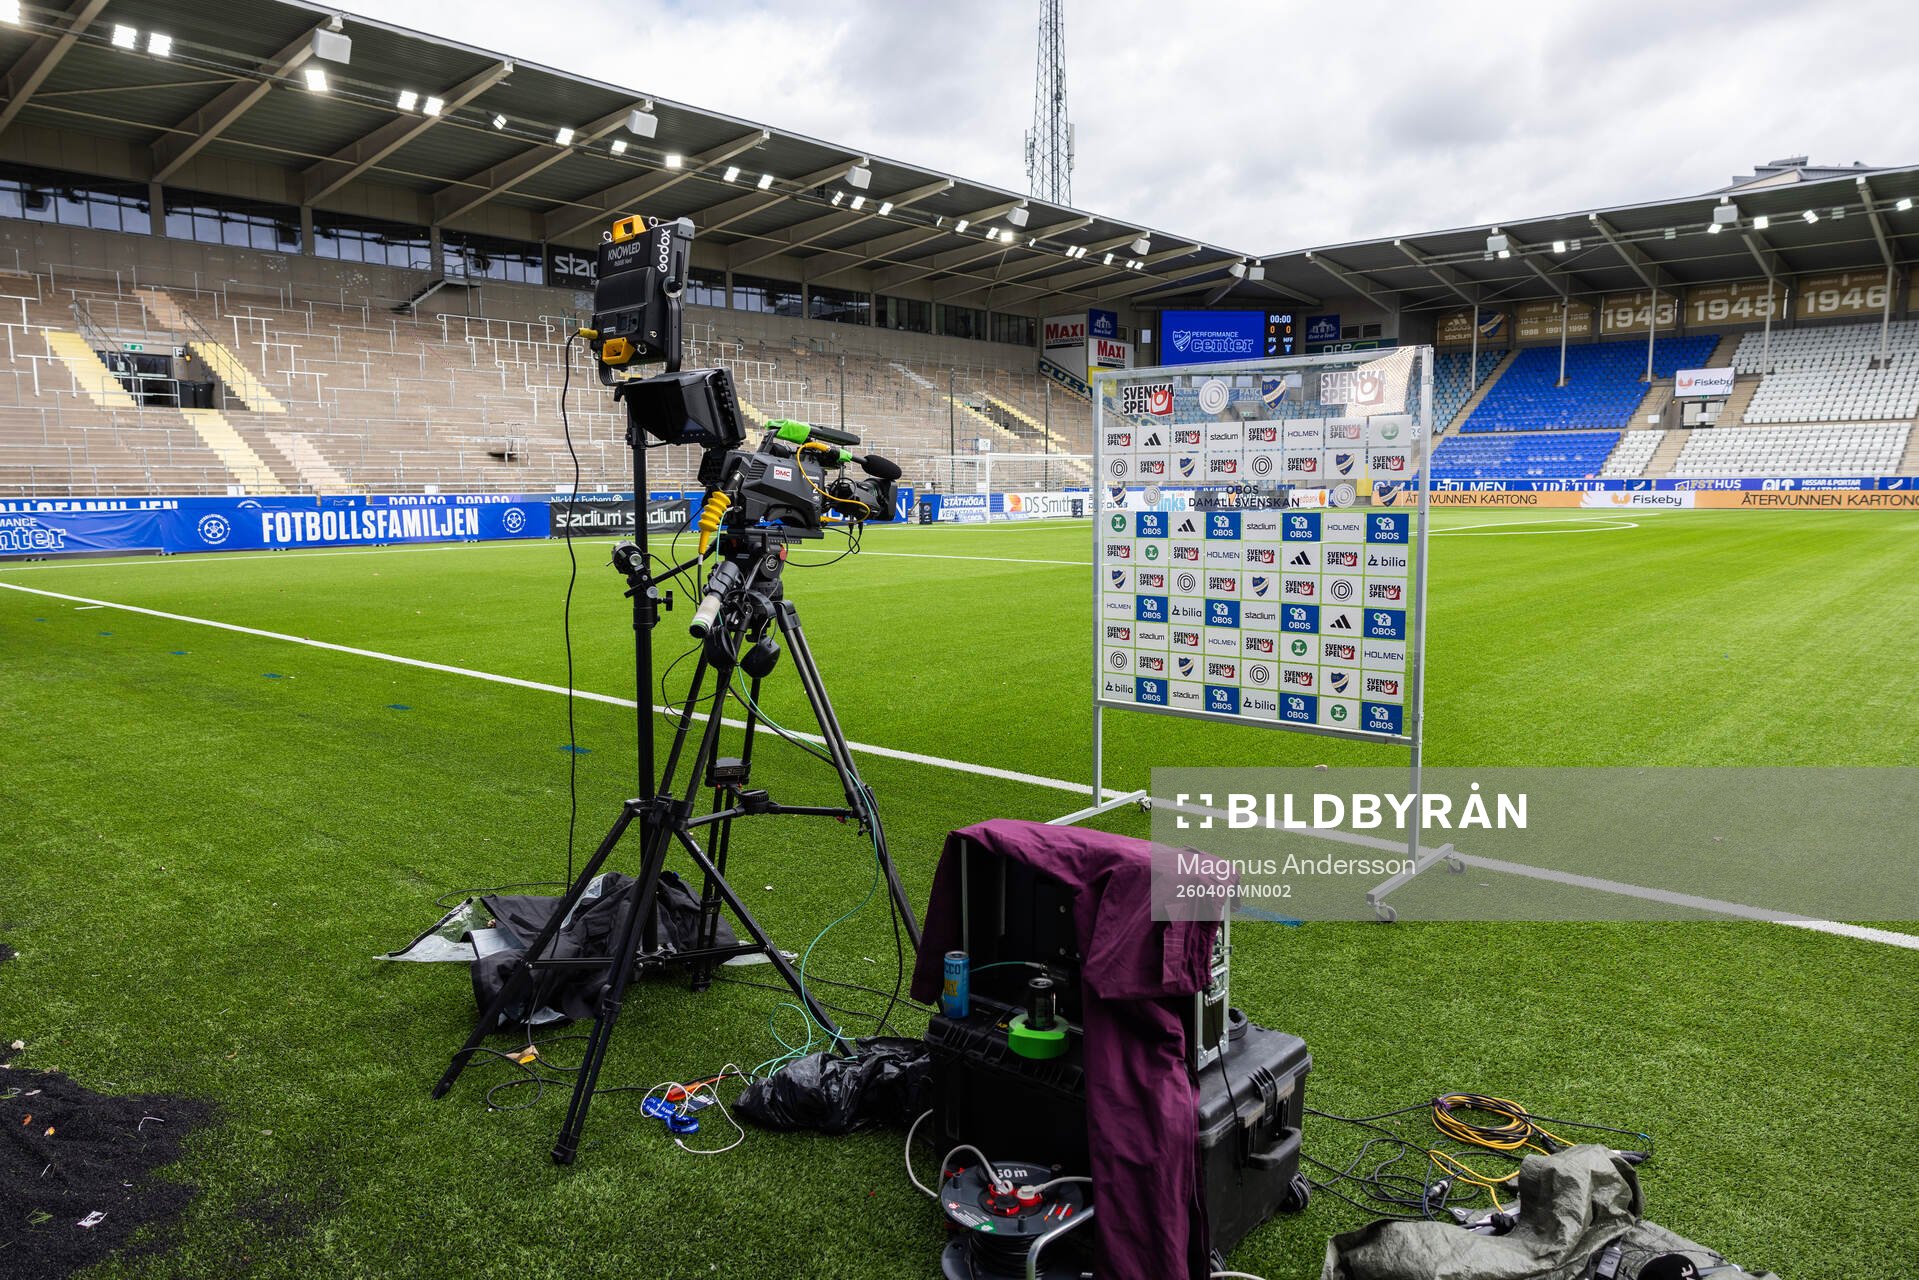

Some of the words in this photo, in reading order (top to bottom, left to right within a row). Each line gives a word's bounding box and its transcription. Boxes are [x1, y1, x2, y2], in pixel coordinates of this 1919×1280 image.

[608, 242, 640, 261] KNOWLED
[657, 228, 670, 273] Godox
[1803, 285, 1887, 313] 1946
[1695, 295, 1776, 321] 1945
[1270, 315, 1291, 323] 00:00
[1604, 303, 1673, 328] 1943
[1045, 323, 1084, 339] MAXI
[1270, 325, 1275, 334] 0
[1286, 325, 1291, 334] 0
[1191, 337, 1254, 352] center
[1097, 340, 1125, 359] MAXI
[1322, 369, 1386, 388] SVENSKA
[1695, 377, 1733, 386] Fiskeby
[1124, 384, 1174, 400] SVENSKA
[1322, 390, 1353, 404] SPEL
[1124, 400, 1149, 414] SPEL
[1175, 430, 1200, 438] SVENSKA
[1140, 460, 1164, 468] SVENSKA
[1372, 456, 1405, 464] SVENSKA
[1288, 464, 1302, 472] SPEL
[1372, 462, 1389, 470] SPEL
[1226, 485, 1258, 494] OBOS
[1189, 498, 1300, 507] DAMALLSVENSKAN
[1406, 492, 1477, 504] ÅTVUNNEN
[1481, 494, 1538, 505] KARTONG
[1633, 494, 1682, 506] Fiskeby
[1741, 492, 1841, 505] ÅTERVUNNEN
[1025, 496, 1039, 513] DS
[1042, 495, 1072, 513] Smith
[626, 508, 686, 525] sdium
[262, 507, 479, 543] FOTBOLLSFAMILJEN
[1290, 530, 1312, 538] OBOS
[1375, 532, 1400, 540] OBOS
[1174, 546, 1199, 554] SVENSKA
[1174, 552, 1186, 560] SPEL
[1382, 557, 1406, 567] bilia
[1286, 580, 1314, 588] SVENSKA
[1370, 584, 1400, 592] SVENSKA
[1286, 586, 1300, 594] SPEL
[1182, 608, 1202, 617] bilia
[1212, 616, 1232, 624] OBOS
[1288, 622, 1310, 630] OBOS
[1372, 628, 1396, 636] OBOS
[1325, 644, 1354, 652] SVENSKA
[1325, 650, 1340, 658] SPEL
[1364, 651, 1404, 660] HOLMEN
[1284, 670, 1312, 678] SVENSKA
[1284, 676, 1298, 684] SPEL
[1367, 678, 1398, 687] SVENSKA
[1115, 685, 1133, 694] bilia
[1142, 694, 1160, 702] OBOS
[1173, 692, 1200, 700] stadium
[1254, 700, 1276, 711] bilia
[1288, 712, 1308, 720] OBOS
[1370, 721, 1394, 730] OBOS
[998, 1168, 1012, 1179] 50
[1014, 1170, 1028, 1178] m
